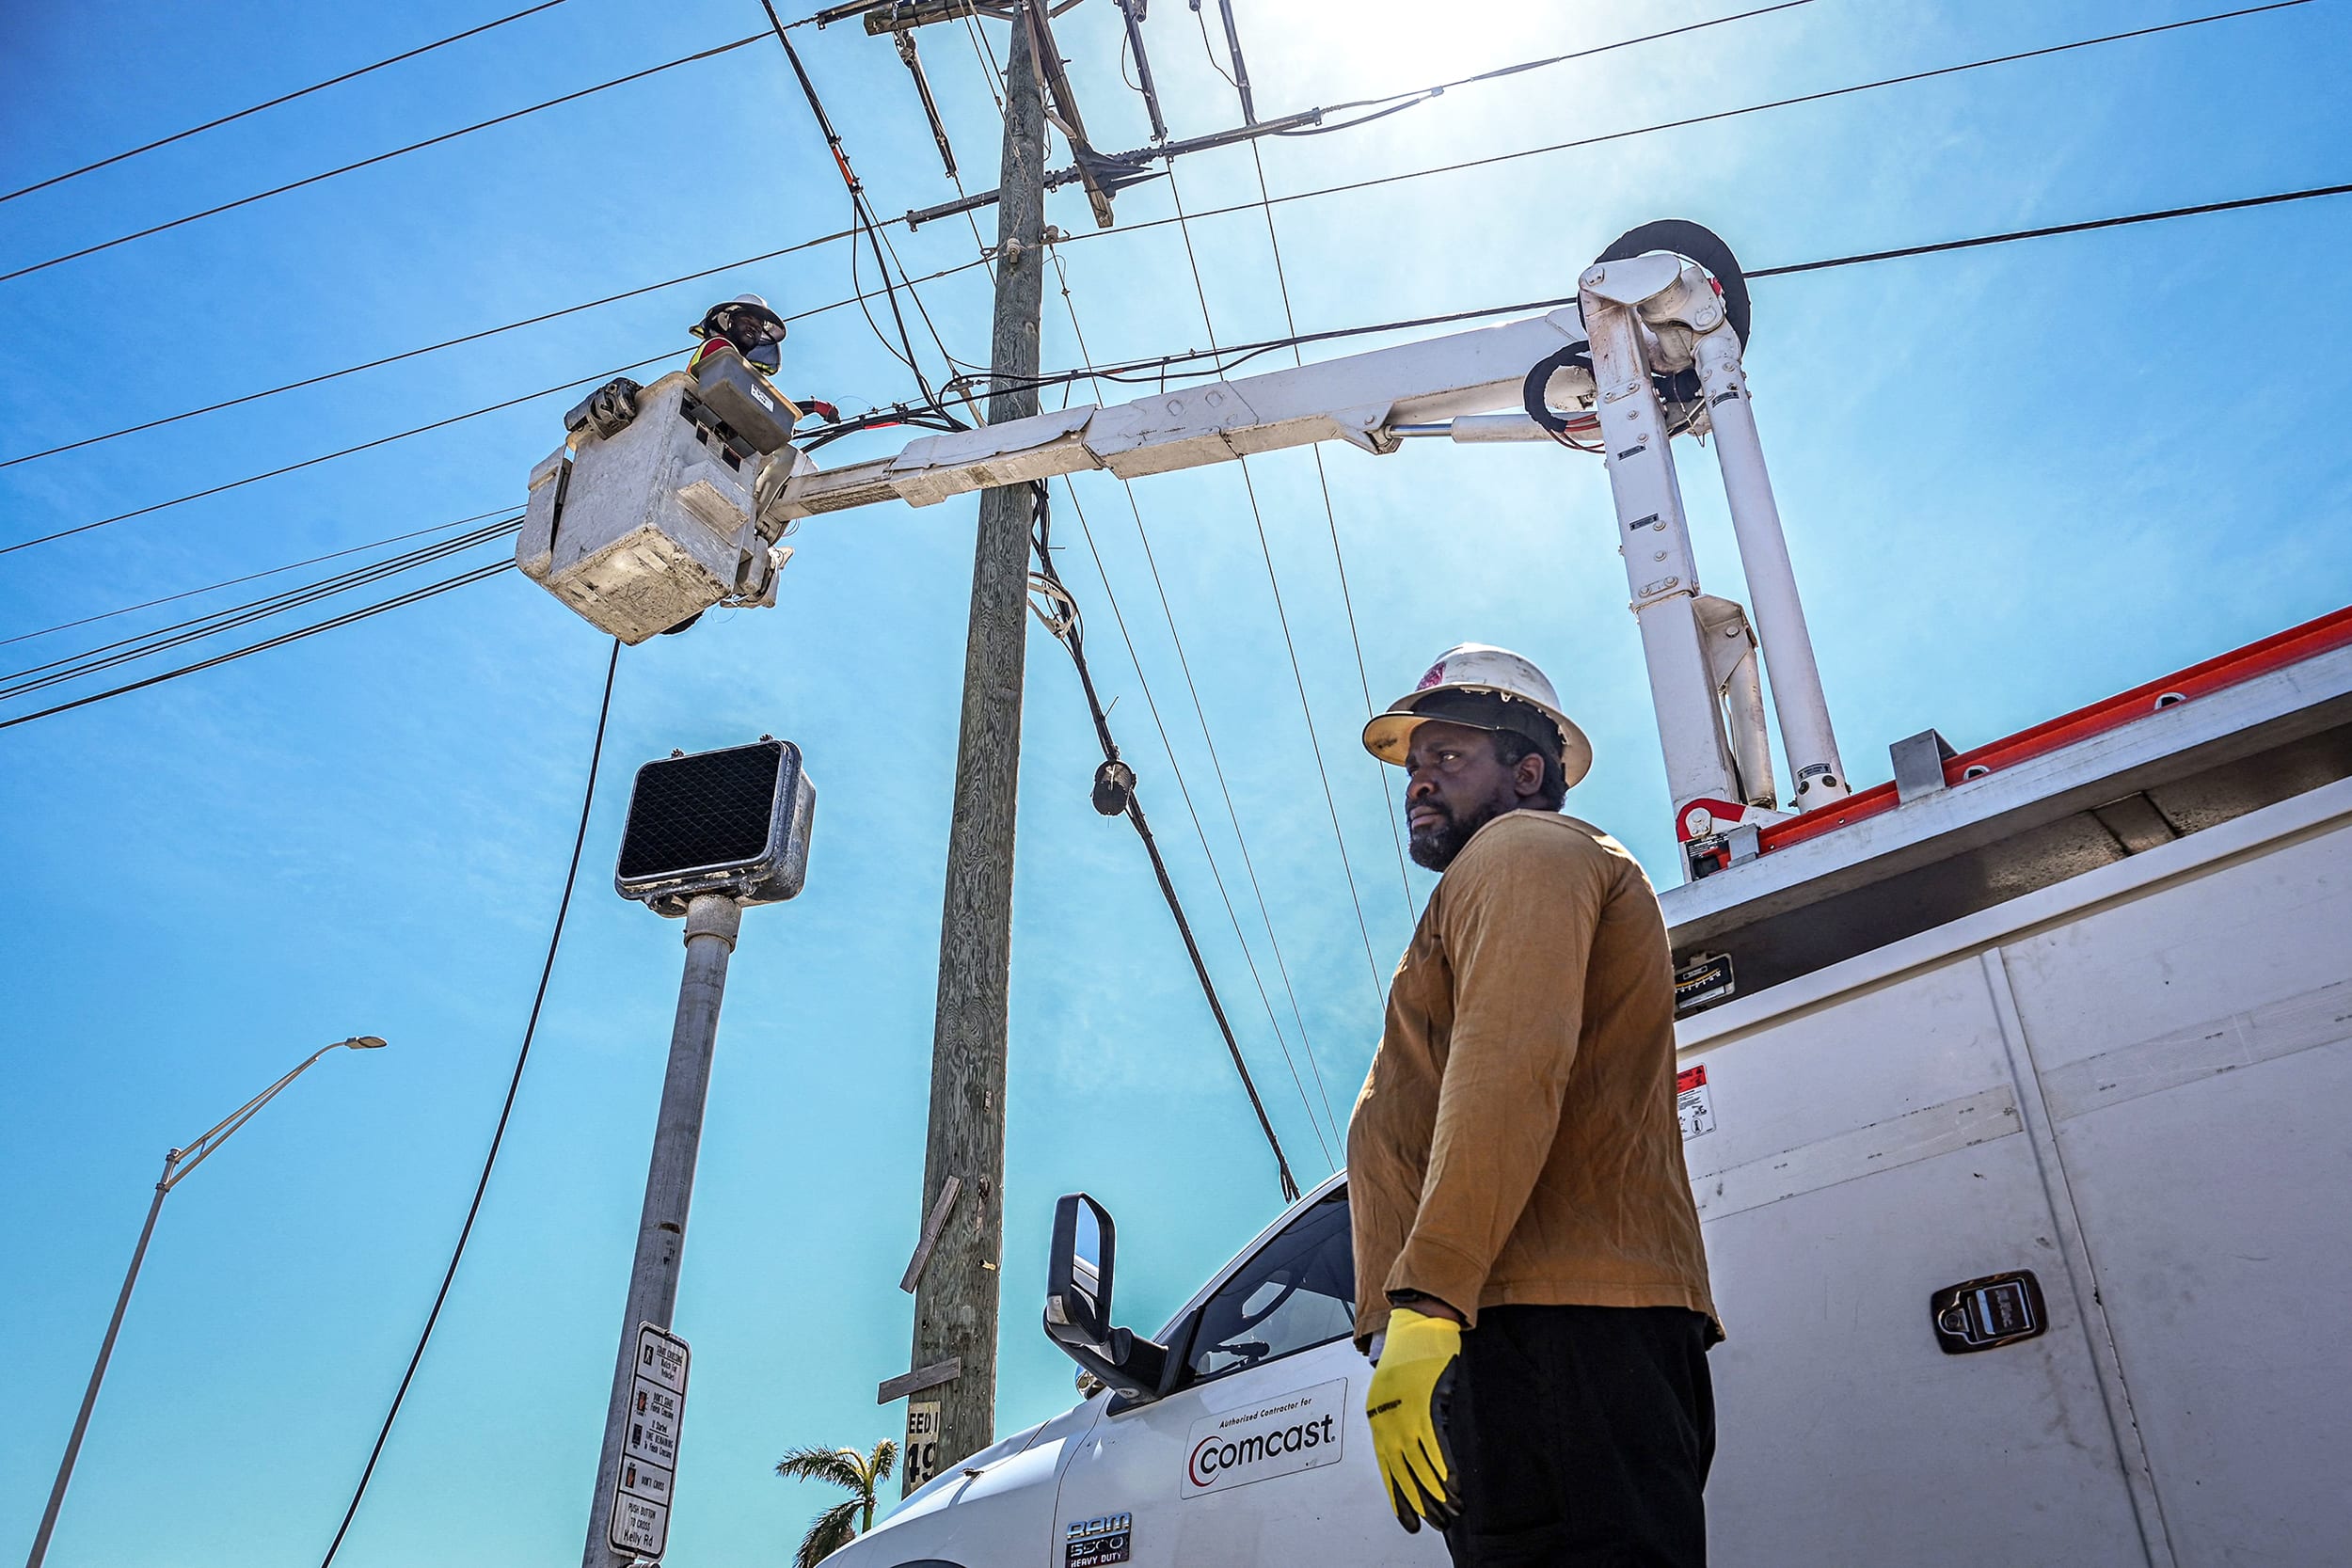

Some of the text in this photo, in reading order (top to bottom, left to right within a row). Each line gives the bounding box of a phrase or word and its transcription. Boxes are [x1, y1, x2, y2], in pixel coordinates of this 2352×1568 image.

[1219, 1397, 1312, 1430] Authorized Contractor for
[624, 1529, 654, 1547] Kelly Rd
[1070, 1551, 1122, 1568] HEAVY DUTY
